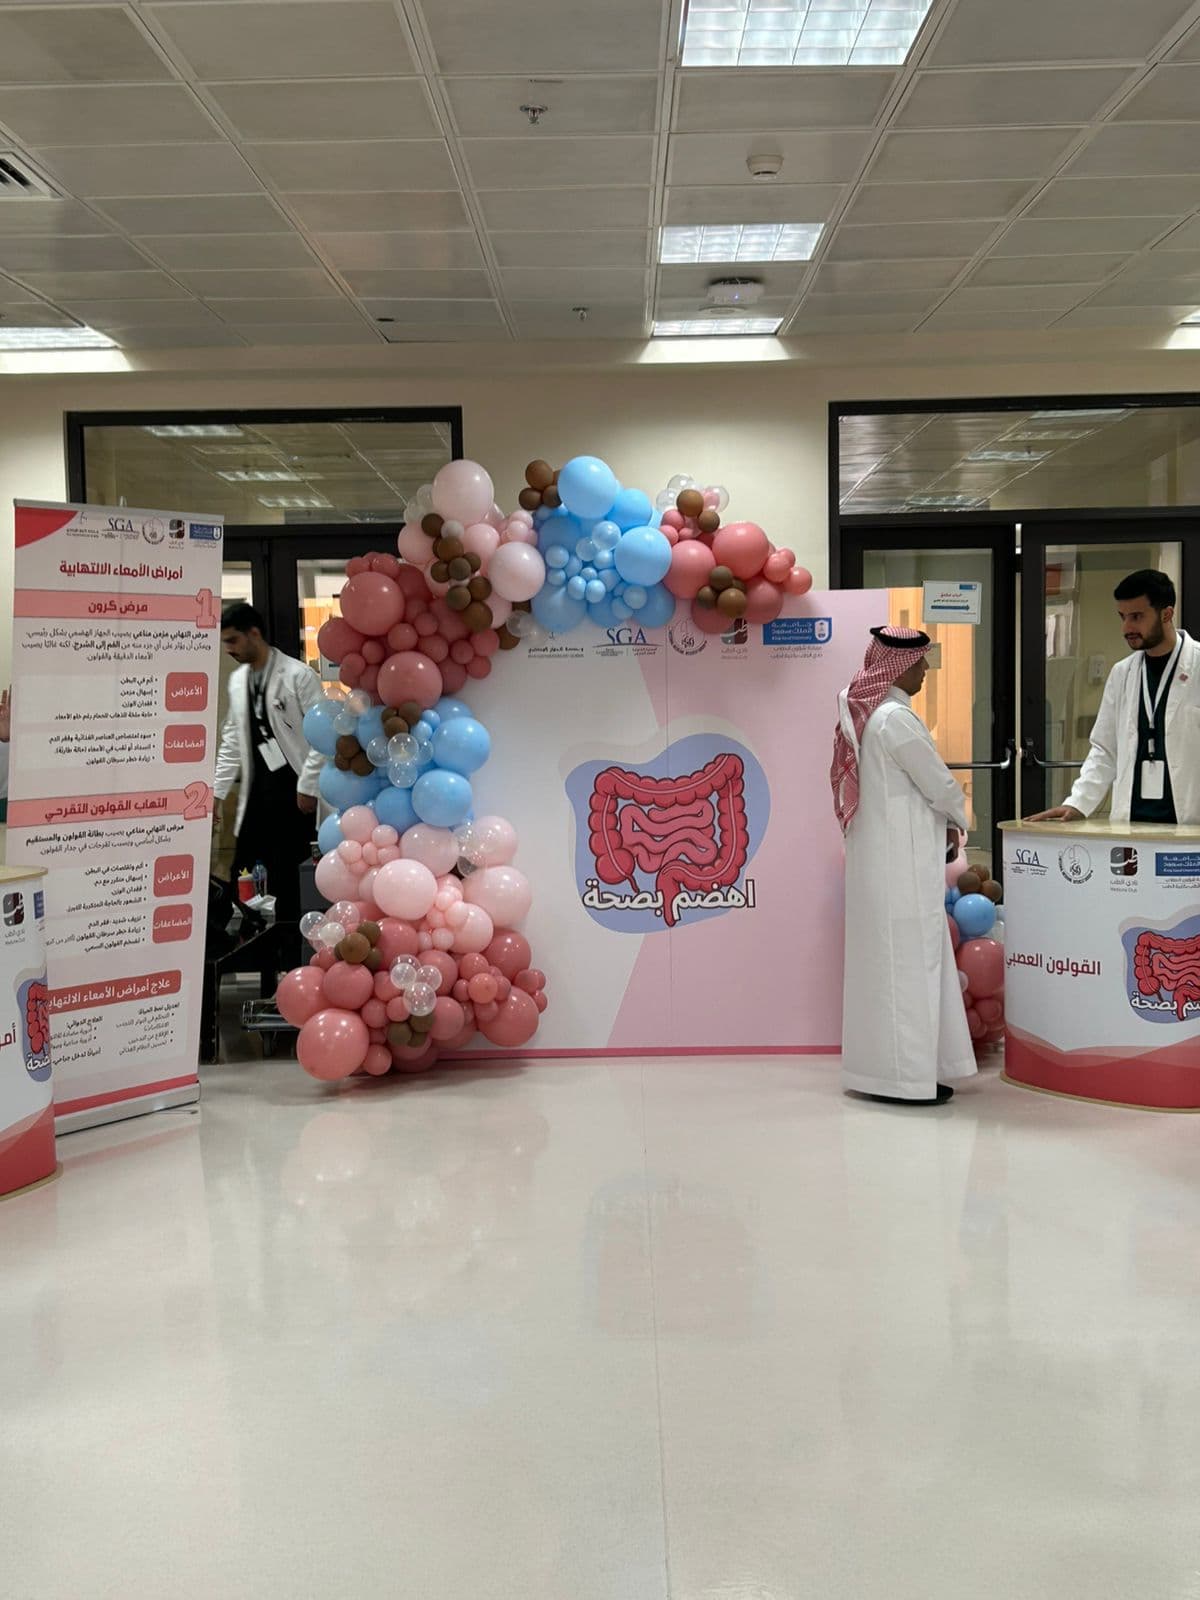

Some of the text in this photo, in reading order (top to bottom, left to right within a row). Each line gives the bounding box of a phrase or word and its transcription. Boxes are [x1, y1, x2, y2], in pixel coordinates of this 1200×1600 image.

[108, 517, 134, 532] SGA
[60, 560, 183, 580] أمراض الأمعاء الالتهابية
[88, 600, 148, 614] مرض كرون
[196, 588, 216, 629] 1
[606, 628, 647, 644] SGA
[171, 685, 202, 698] الأعراض
[164, 738, 204, 748] المضاعفات
[90, 800, 131, 816] القولون
[184, 780, 209, 820] 2
[45, 803, 88, 823] التقرحي
[26, 833, 60, 846] والمستقيم
[62, 831, 87, 842] القولون
[1016, 849, 1040, 864] SGA
[158, 870, 189, 884] الأعراض
[582, 879, 756, 921] اهضم بصحة
[154, 917, 191, 930] المضاعفات
[1006, 952, 1100, 977] القولون العصبي
[83, 986, 115, 1002] الأمعاء
[116, 979, 149, 998] أمراض
[151, 978, 170, 994] علاج
[1130, 990, 1178, 1015] بصحة
